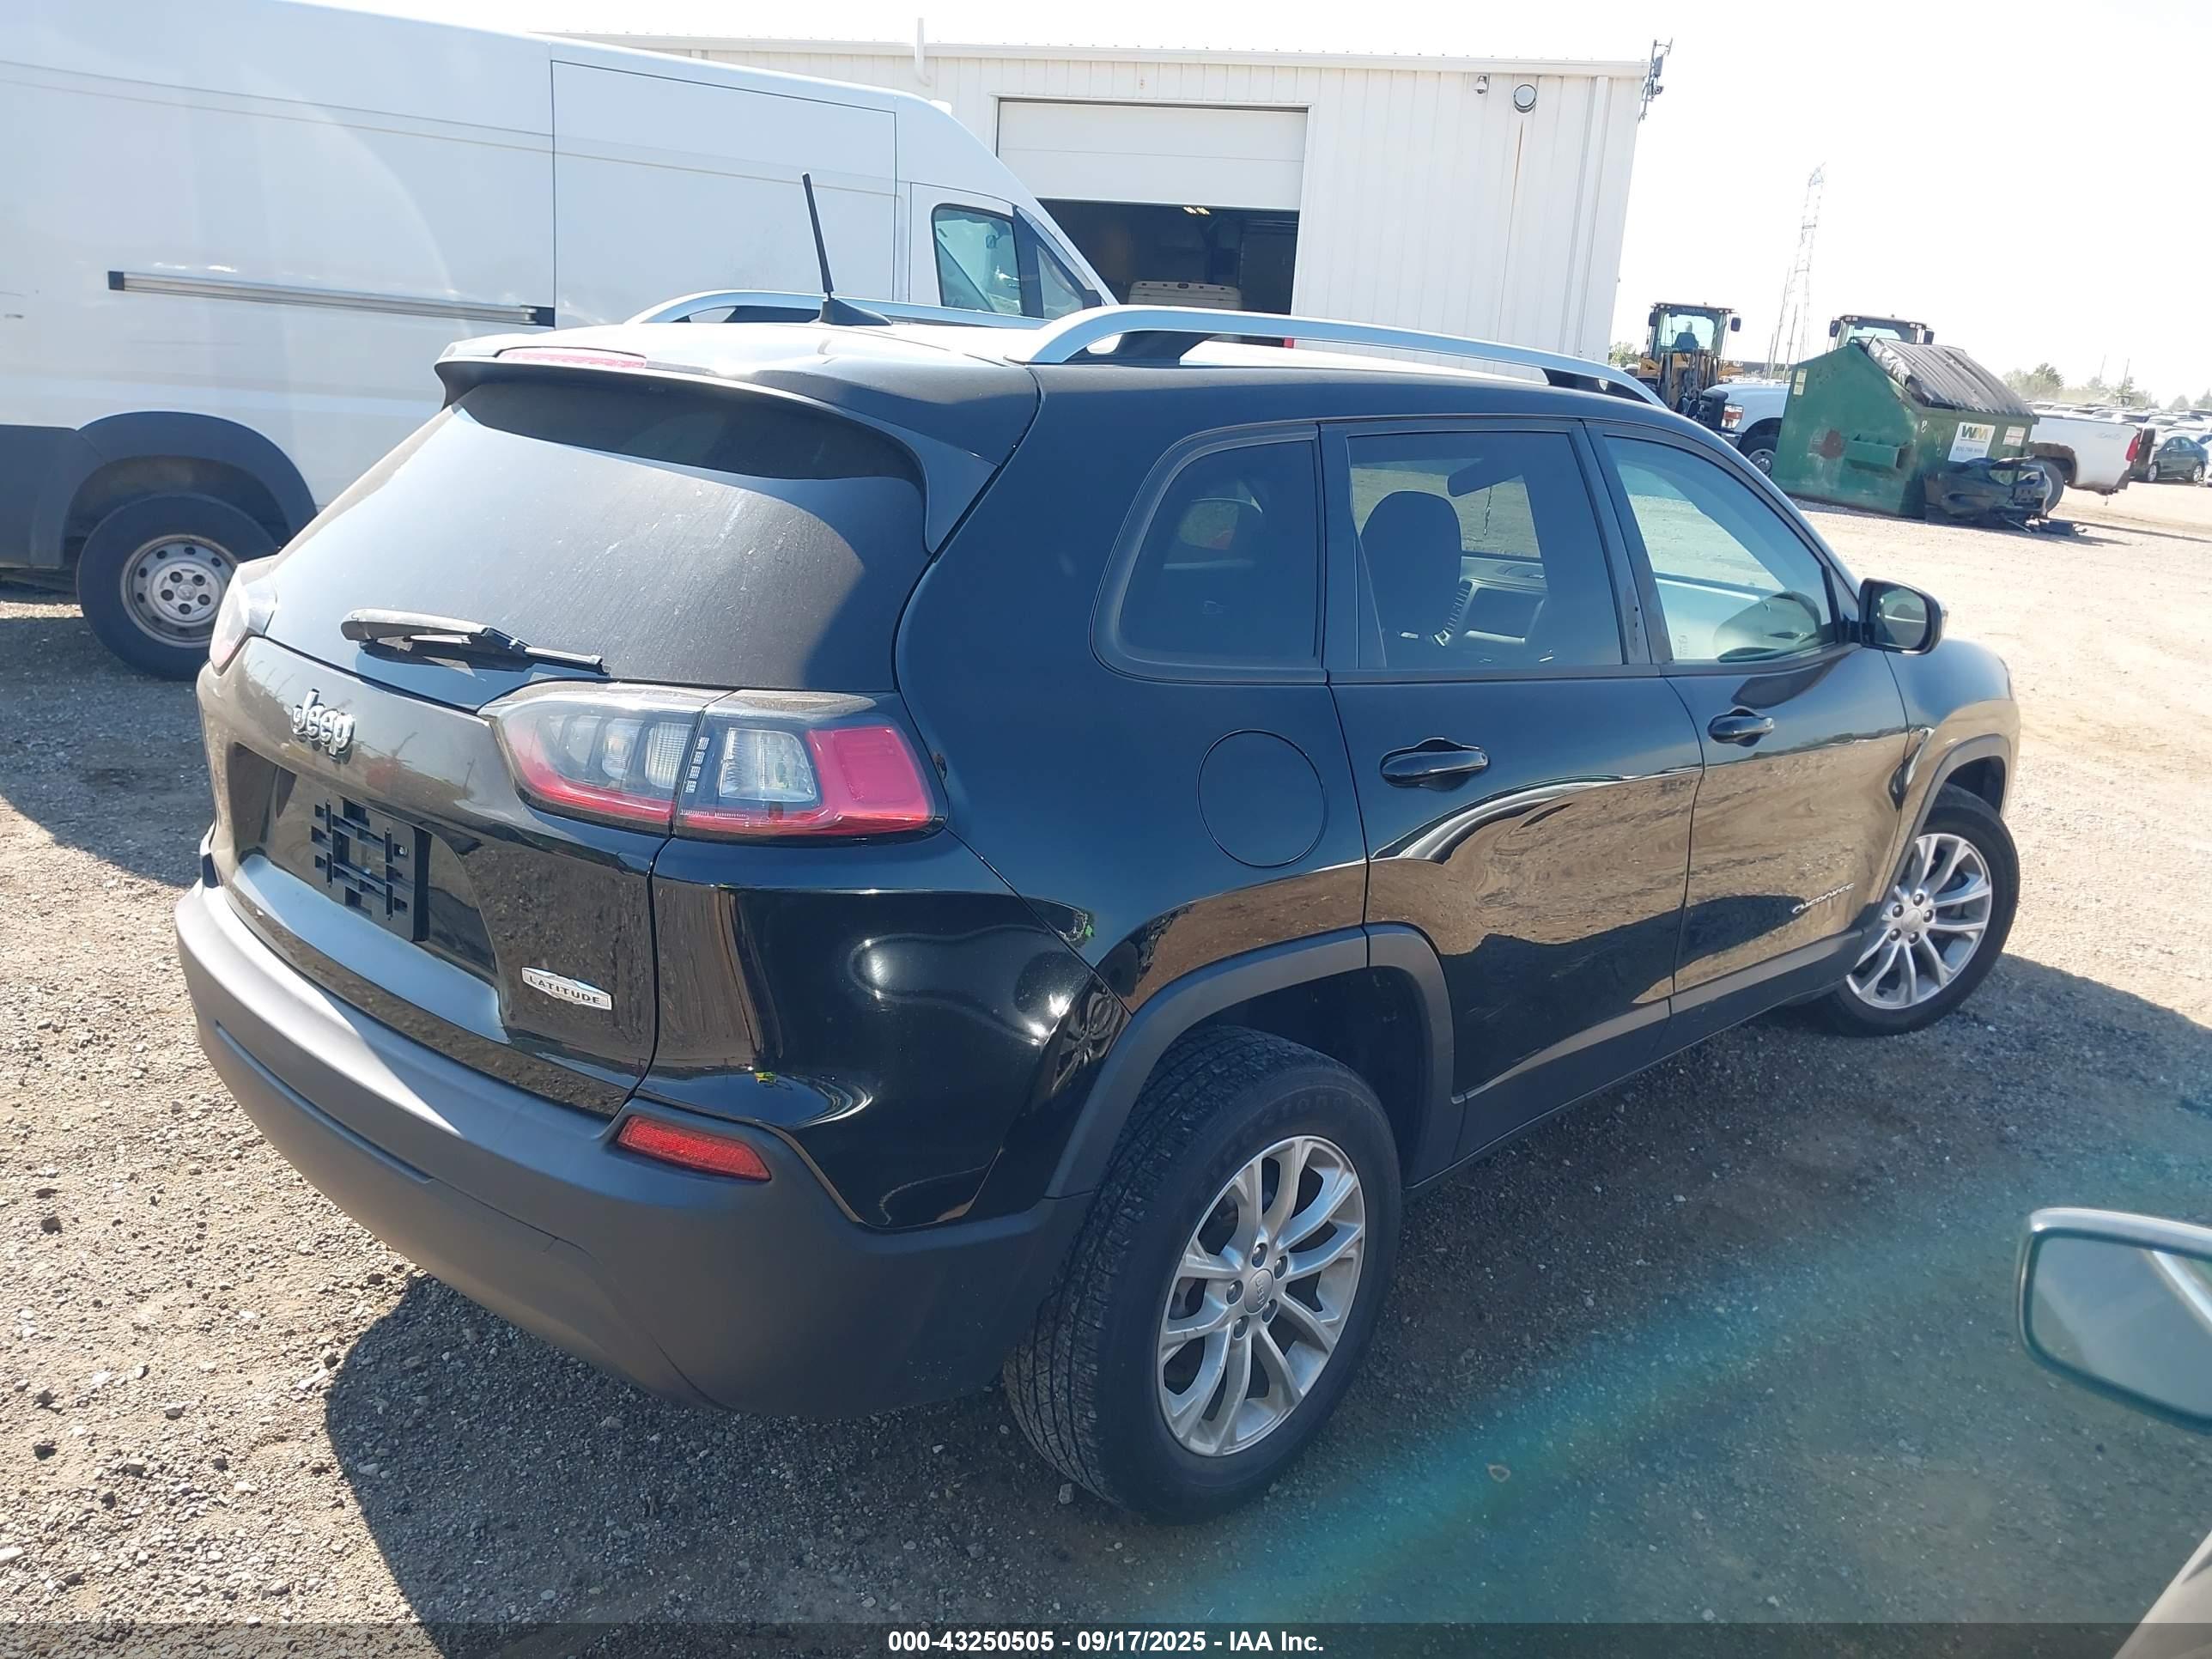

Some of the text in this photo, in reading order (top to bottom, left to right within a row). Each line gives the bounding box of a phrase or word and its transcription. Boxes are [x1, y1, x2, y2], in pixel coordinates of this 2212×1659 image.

[1961, 425, 1988, 440] WM
[292, 689, 355, 757] Jeep
[529, 975, 600, 1004] LATITUDE
